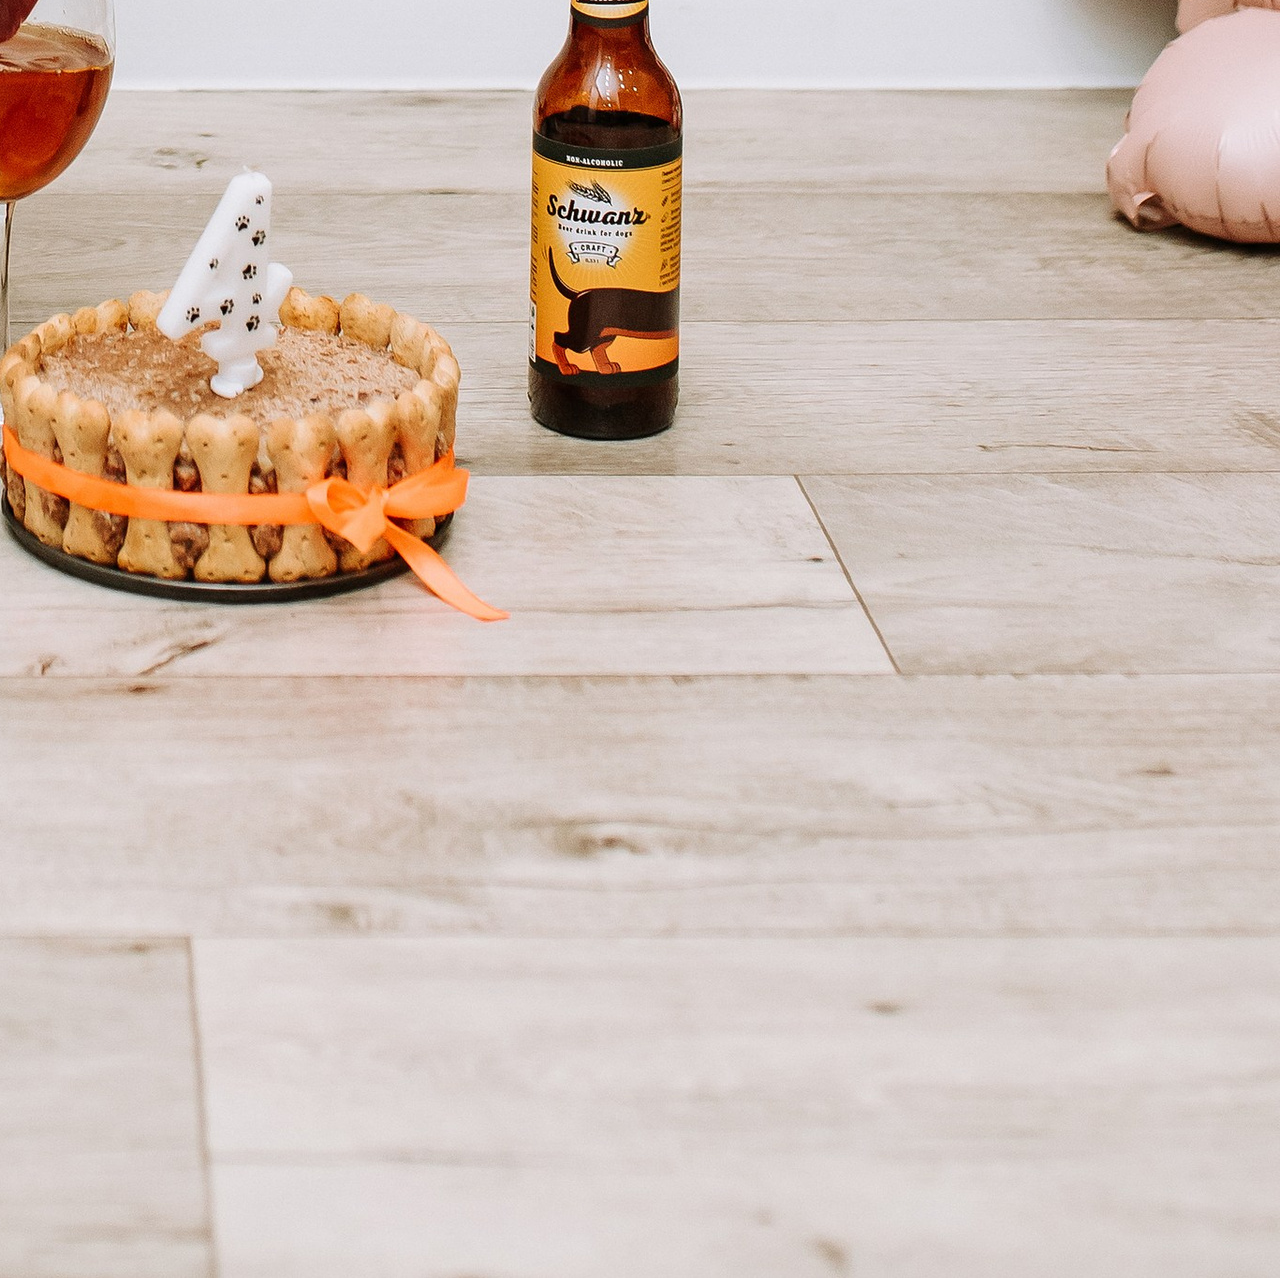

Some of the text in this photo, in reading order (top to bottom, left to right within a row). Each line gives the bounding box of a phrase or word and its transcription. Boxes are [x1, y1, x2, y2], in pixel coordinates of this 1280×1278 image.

[566, 154, 624, 168] NON-ALCOHOLIC
[547, 194, 649, 226] Schwanz
[558, 223, 633, 239] Beer drink for dogs
[580, 244, 606, 253] CRAFT
[156, 171, 292, 378] 4
